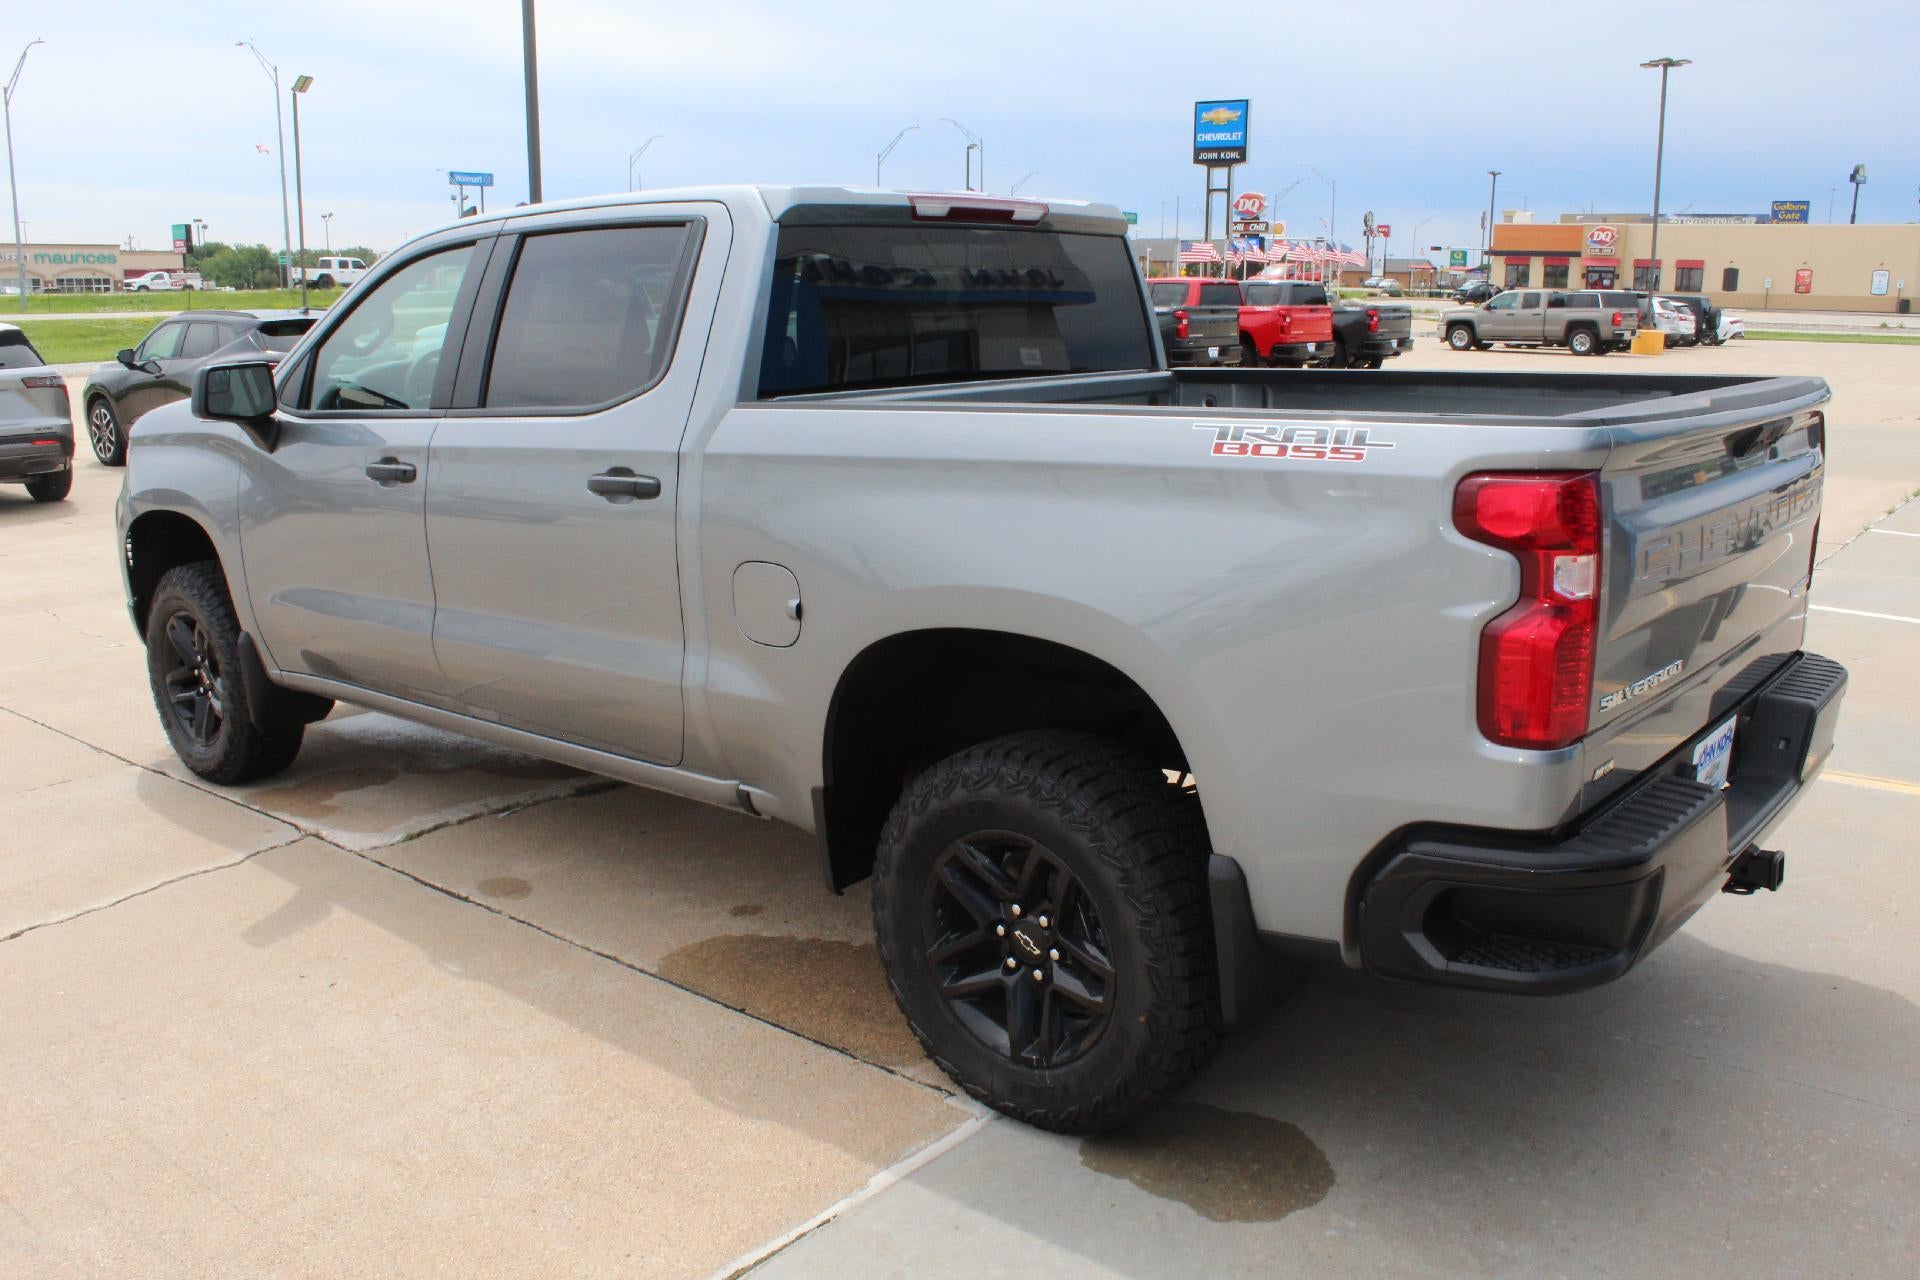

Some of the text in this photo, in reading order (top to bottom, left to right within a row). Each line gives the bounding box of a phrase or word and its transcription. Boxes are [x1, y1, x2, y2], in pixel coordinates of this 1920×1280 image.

[1197, 132, 1243, 142] CHEVROLET
[1198, 151, 1240, 160] JOHN KOHL
[1238, 199, 1260, 213] DQ
[1593, 231, 1611, 242] DQ
[1192, 423, 1396, 449] TRAIL
[1211, 442, 1368, 463] BOSS
[1641, 478, 1823, 580] CHEVROLET
[1599, 660, 1684, 712] SILVERADO
